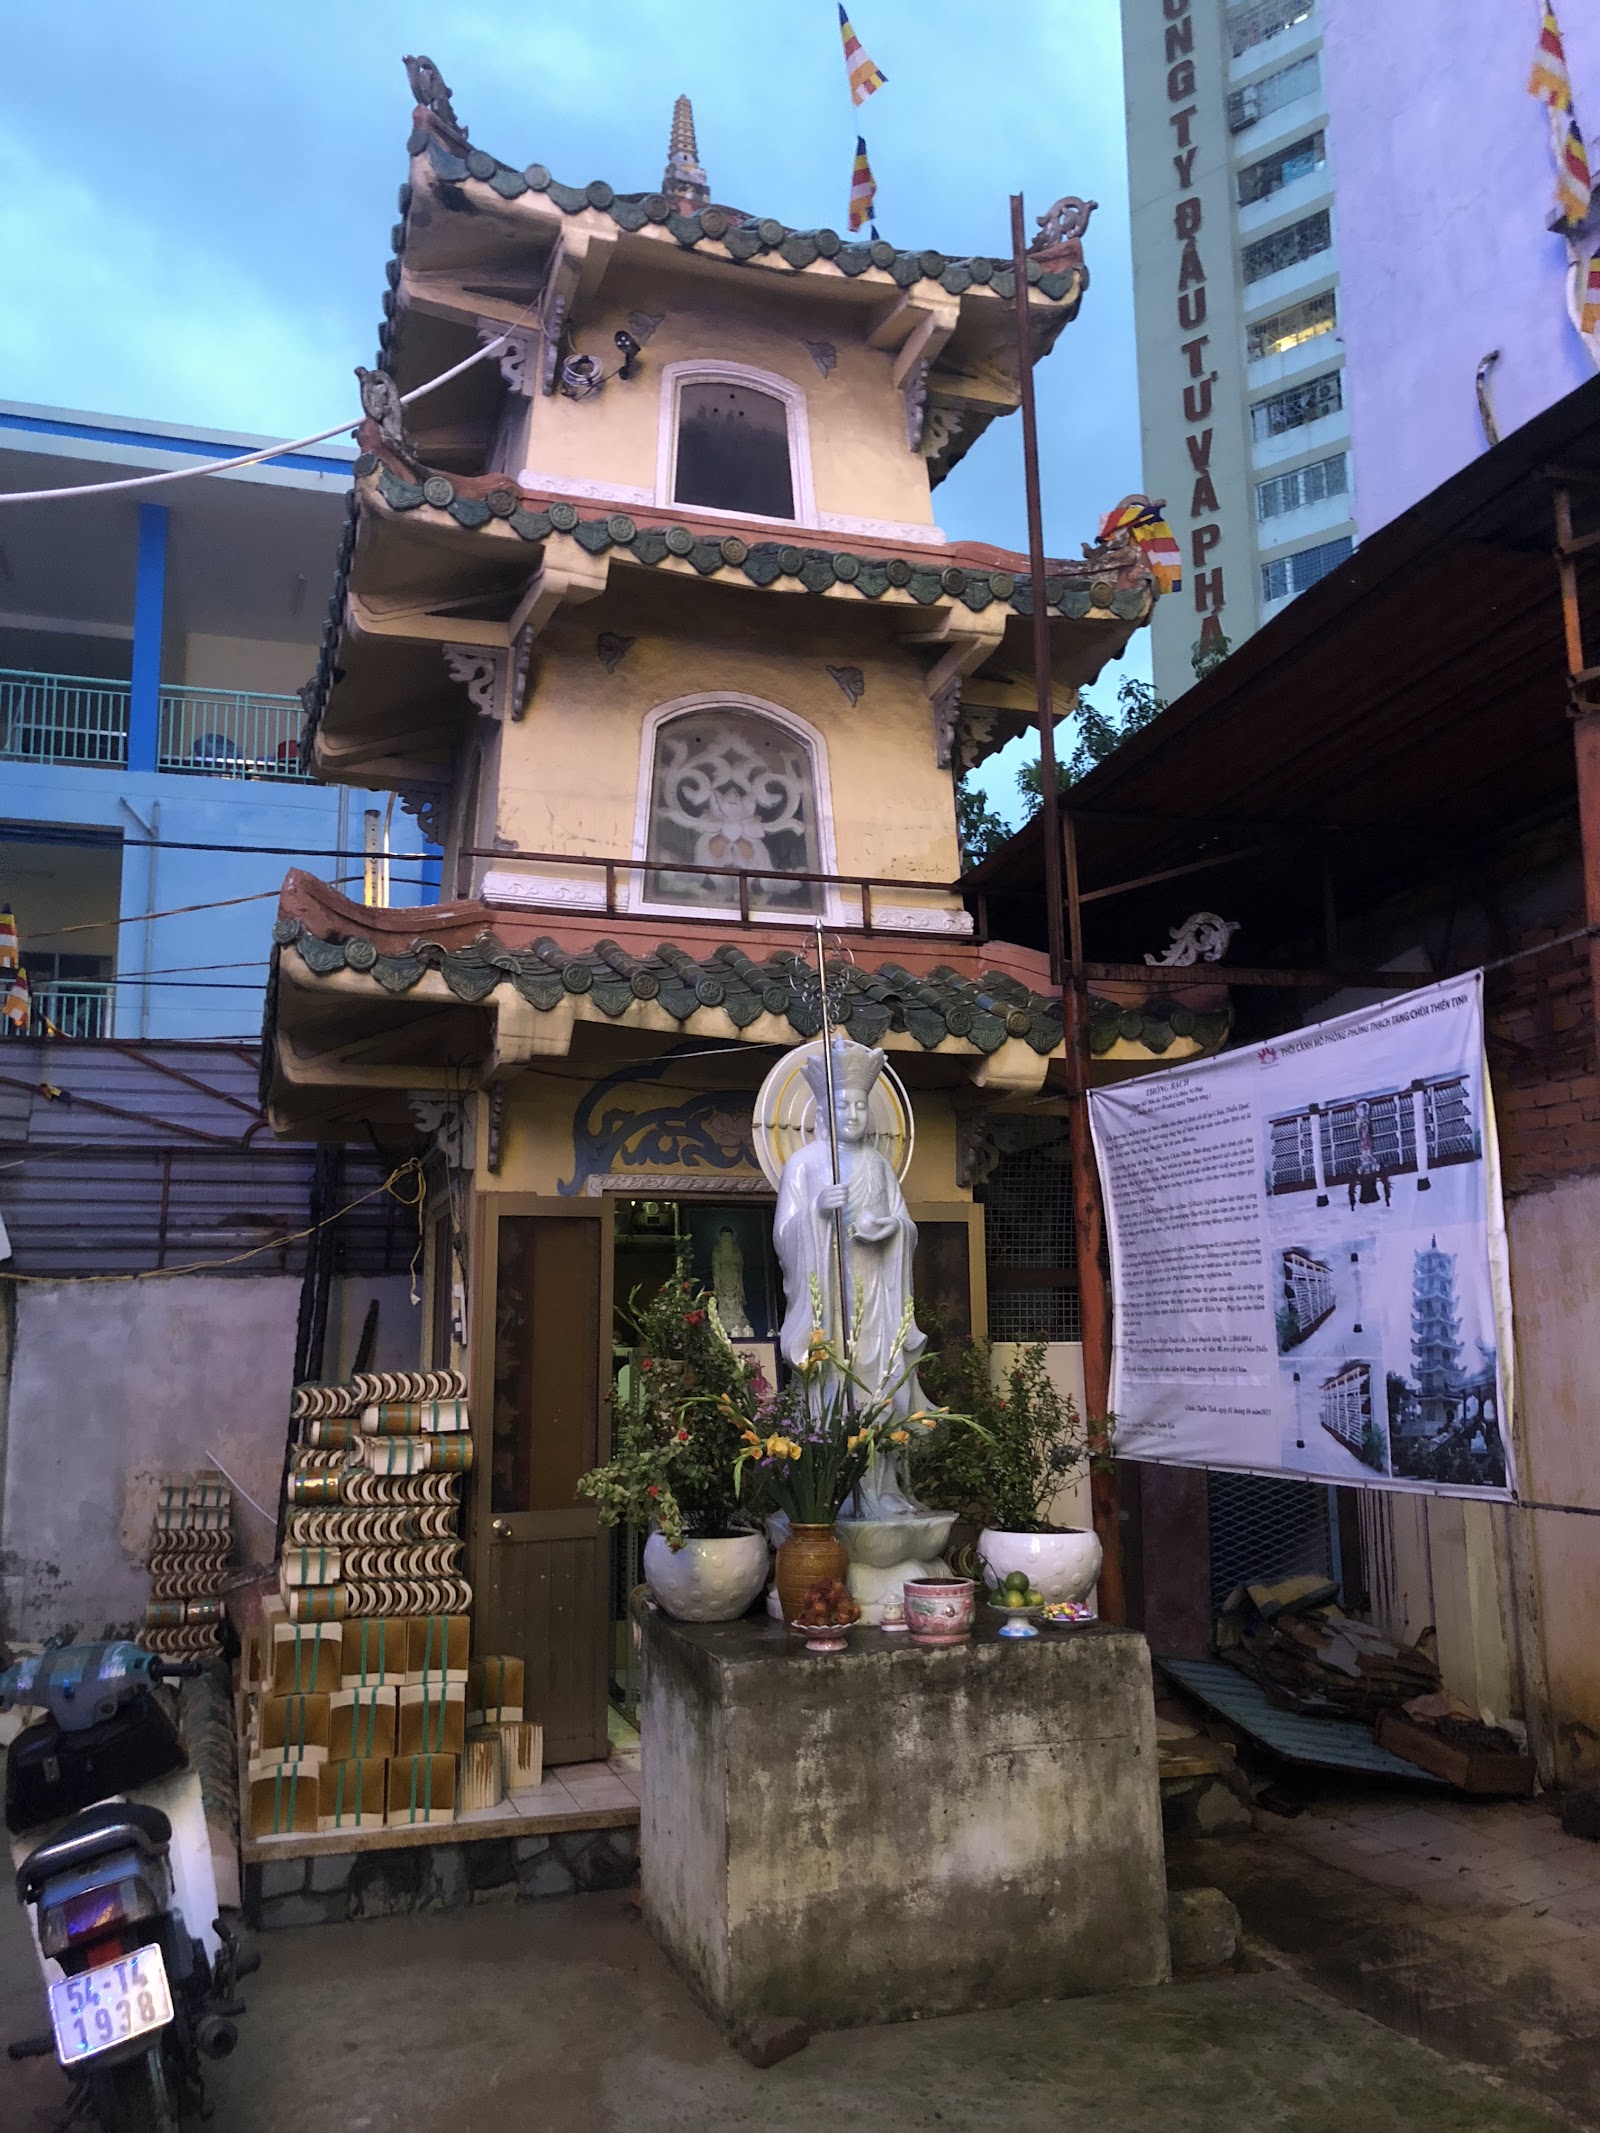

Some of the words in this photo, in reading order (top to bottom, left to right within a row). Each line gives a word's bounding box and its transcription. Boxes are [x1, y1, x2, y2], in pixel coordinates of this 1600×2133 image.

[1170, 105, 1199, 190] TY
[67, 1955, 149, 2015] 54-T4
[73, 1991, 155, 2052] 1938
